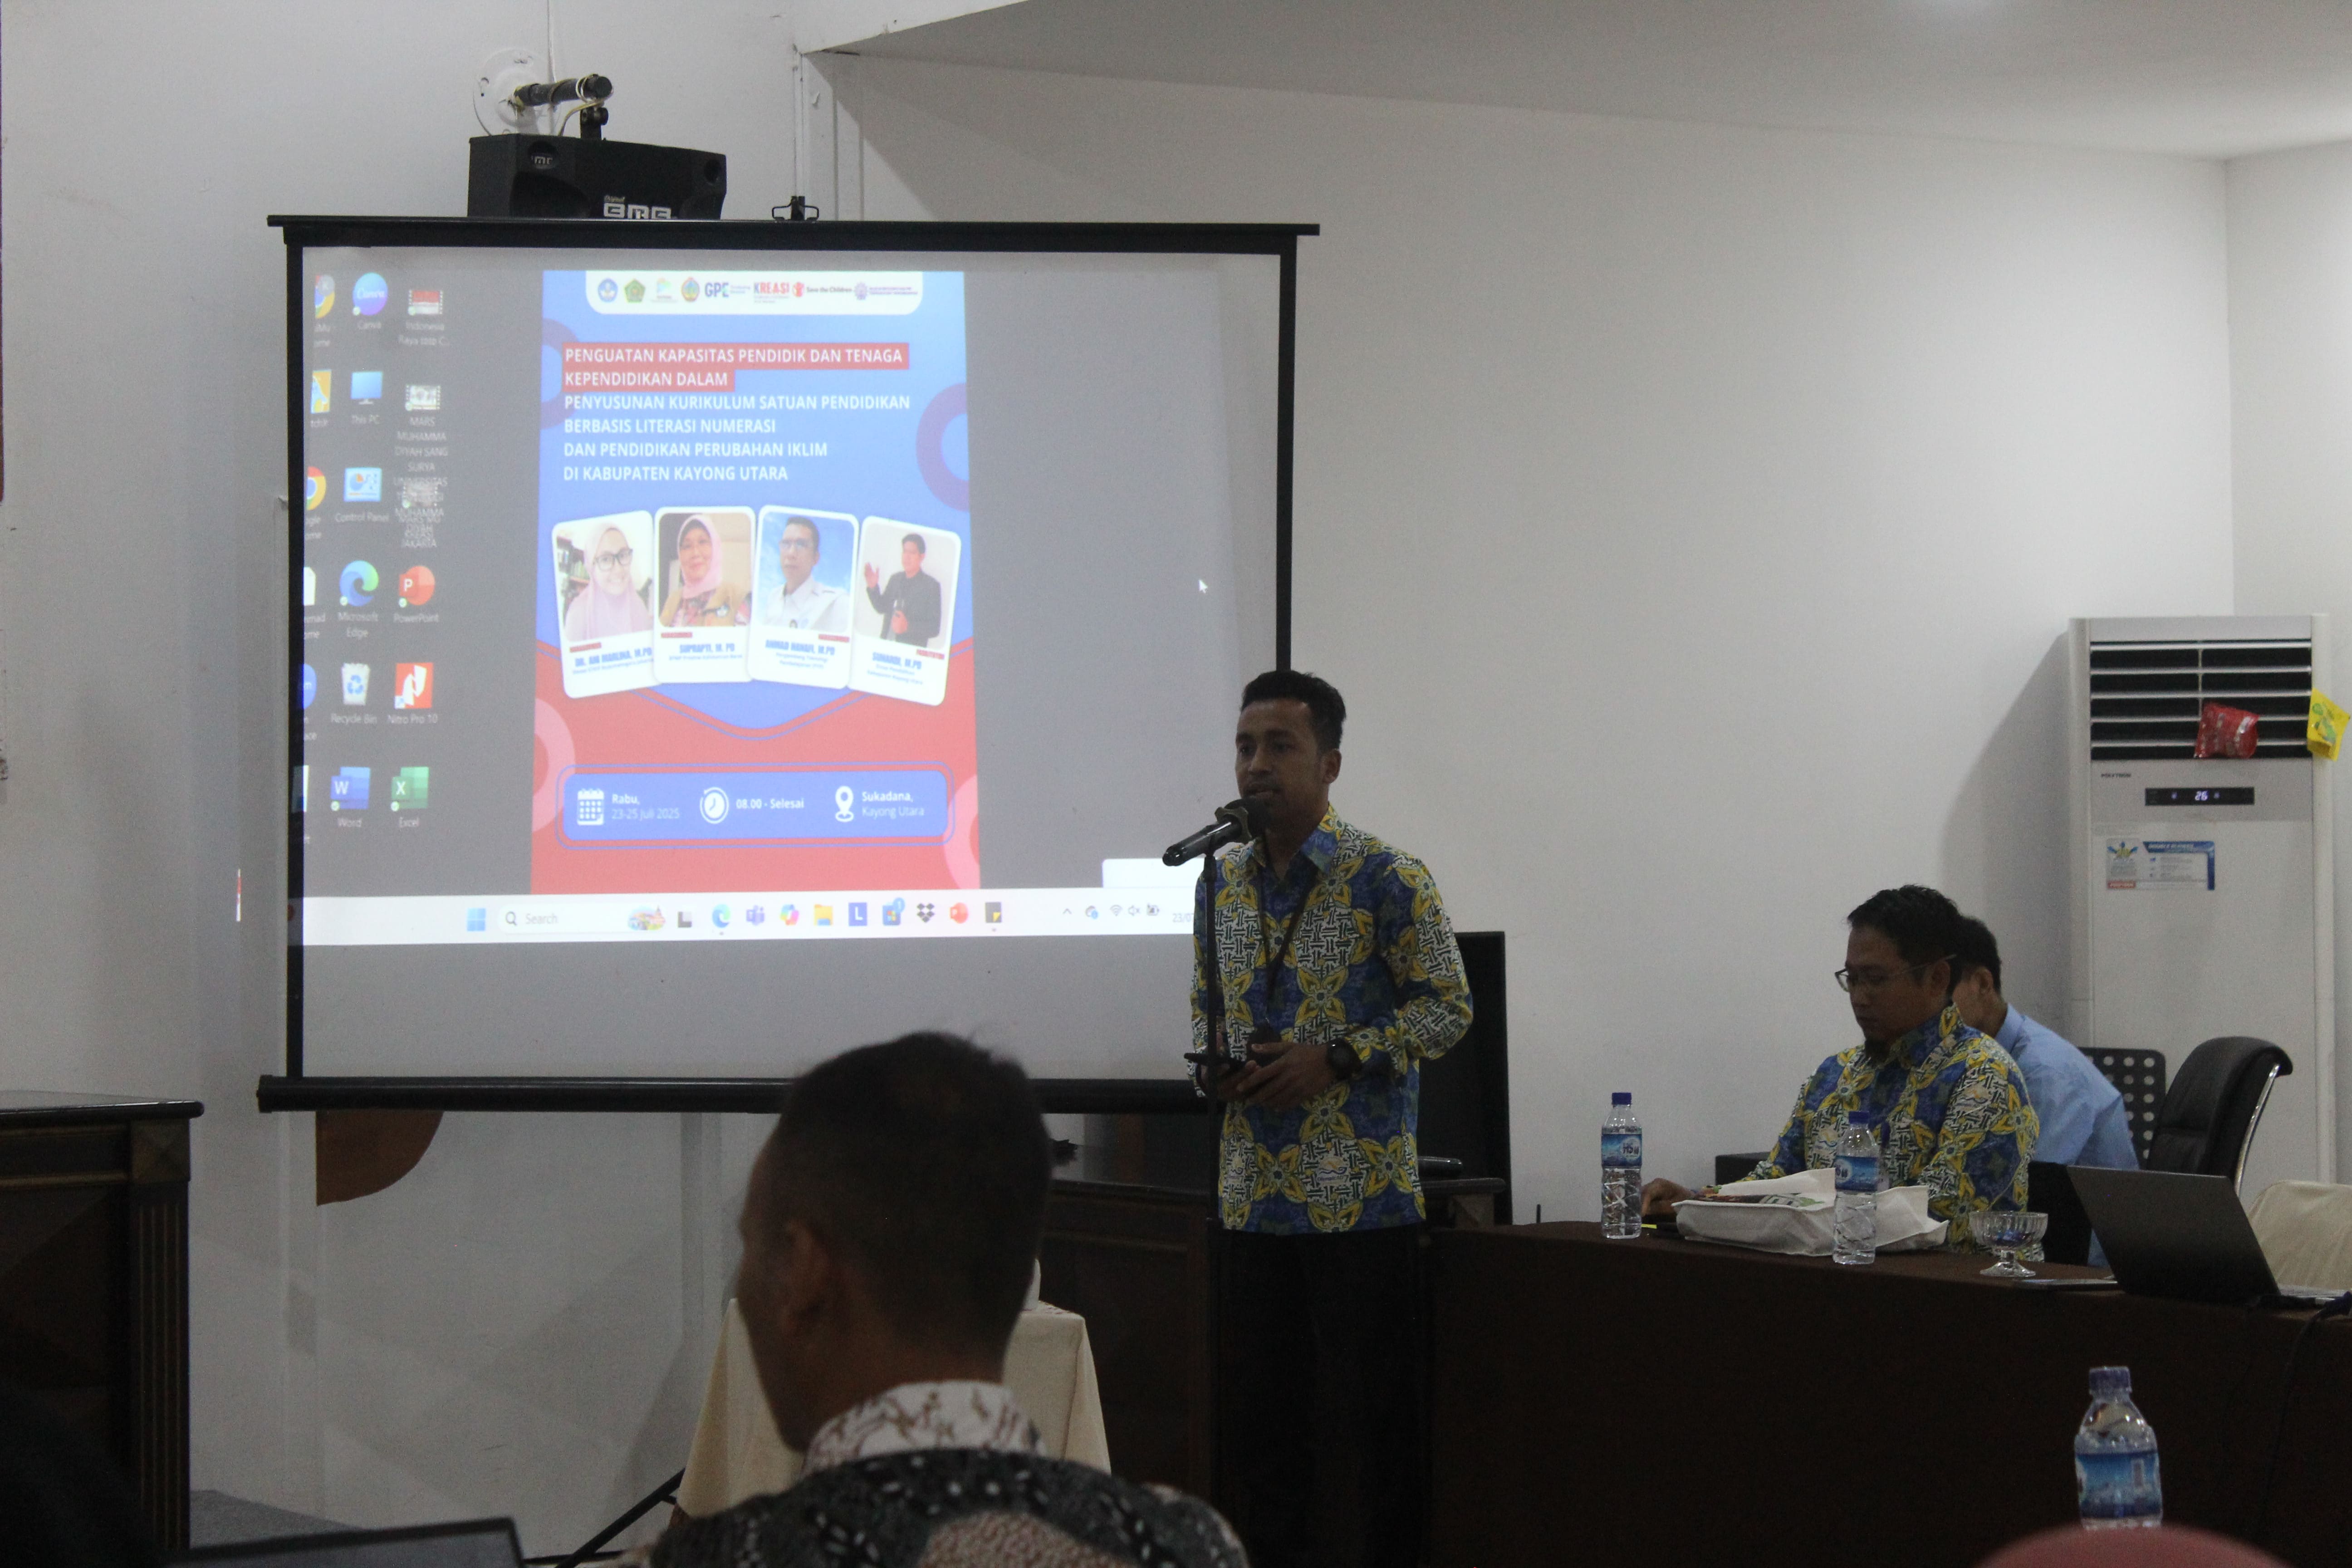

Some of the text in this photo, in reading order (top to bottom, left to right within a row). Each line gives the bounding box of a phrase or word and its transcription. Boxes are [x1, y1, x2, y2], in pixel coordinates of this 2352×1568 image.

[705, 282, 729, 298] GPE
[566, 348, 903, 363] PENGUATAN KAPASITAS PENDIDIK DAN TENAGA
[565, 372, 728, 387] KEPENDIDIKAN DALAM
[565, 396, 910, 411] PENYUSUNAN KURIKULUM SATUAN PENDIDIKAN
[564, 419, 776, 434] BERBASIS LITERASI NUMERASI
[564, 443, 828, 457] DAN PENDIDIKAN PERUBAHAN IKLIM
[564, 466, 789, 481] DI KABUPATEN KAYONG UTARA
[334, 780, 349, 795] W
[396, 780, 406, 795] X
[612, 794, 640, 805] Rabu,
[736, 799, 762, 809] 08.00
[770, 799, 805, 809] Selesai
[862, 791, 914, 803] Sukadana,
[862, 807, 925, 820] Kayong Utara
[525, 913, 558, 925] Search
[854, 906, 863, 920] L
